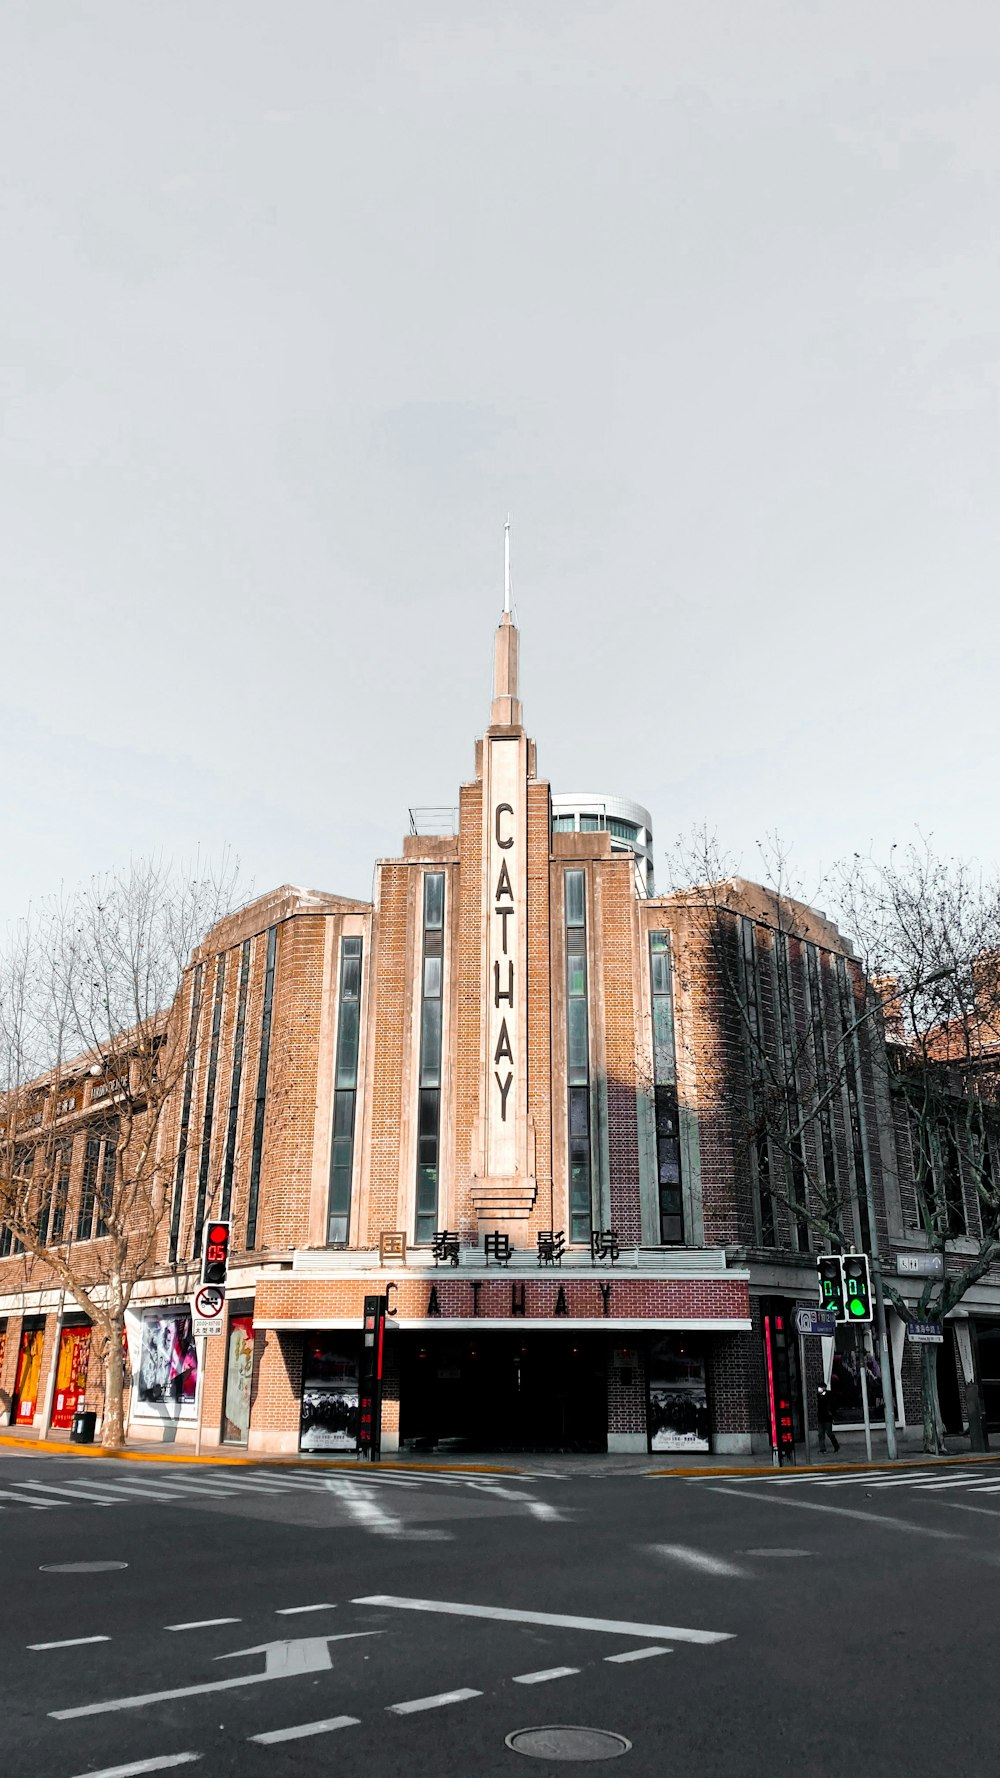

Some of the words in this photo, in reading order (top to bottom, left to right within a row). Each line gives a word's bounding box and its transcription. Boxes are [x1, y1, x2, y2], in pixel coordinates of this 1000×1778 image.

[494, 803, 515, 1122] CATHAY
[207, 1245, 225, 1261] 05
[379, 1230, 620, 1261] 国泰电影院
[385, 1282, 611, 1315] CATHAY
